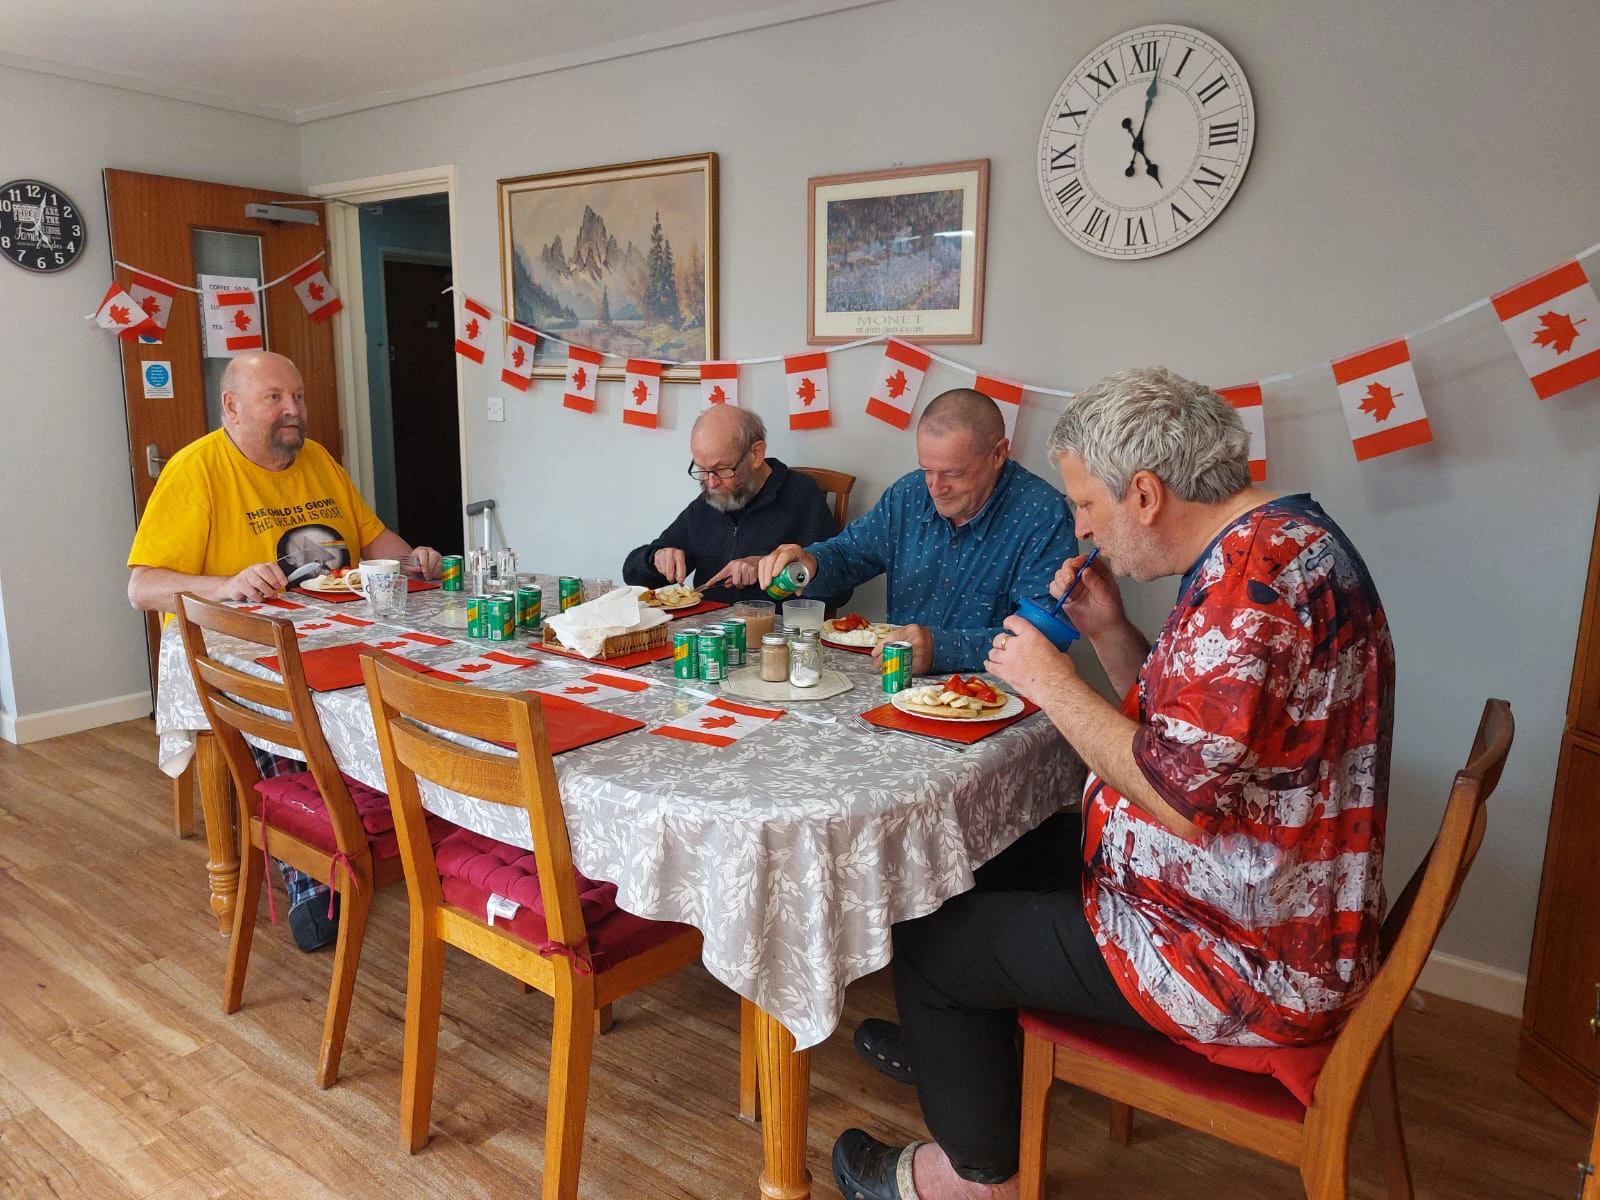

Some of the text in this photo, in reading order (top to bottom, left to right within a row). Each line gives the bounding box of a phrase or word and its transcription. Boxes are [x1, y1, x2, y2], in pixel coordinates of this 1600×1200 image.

[1128, 40, 1160, 75] XII
[1172, 46, 1195, 79] I
[1086, 57, 1118, 99] XI
[1196, 73, 1230, 107] II
[1057, 98, 1088, 129] X
[1208, 119, 1239, 149] III
[1050, 143, 1076, 173] IX
[25, 184, 41, 198] 12
[1193, 163, 1227, 201] IV
[8, 189, 21, 202] 11
[50, 193, 58, 206] 1
[1055, 176, 1086, 216] VIII
[0, 200, 11, 212] 0
[63, 206, 72, 218] 2
[1082, 206, 1111, 242] VII
[1170, 202, 1194, 233] V
[72, 225, 80, 236] 3
[1124, 215, 1150, 247] VI
[1, 236, 11, 248] 8
[66, 241, 75, 253] 4
[17, 249, 26, 262] 7
[37, 257, 47, 269] 6
[55, 252, 64, 264] 5
[857, 314, 922, 325] MONET
[246, 508, 266, 520] THE
[267, 507, 292, 517] CHILD
[292, 505, 303, 514] IS
[249, 517, 273, 536] THE
[308, 510, 319, 520] IS
